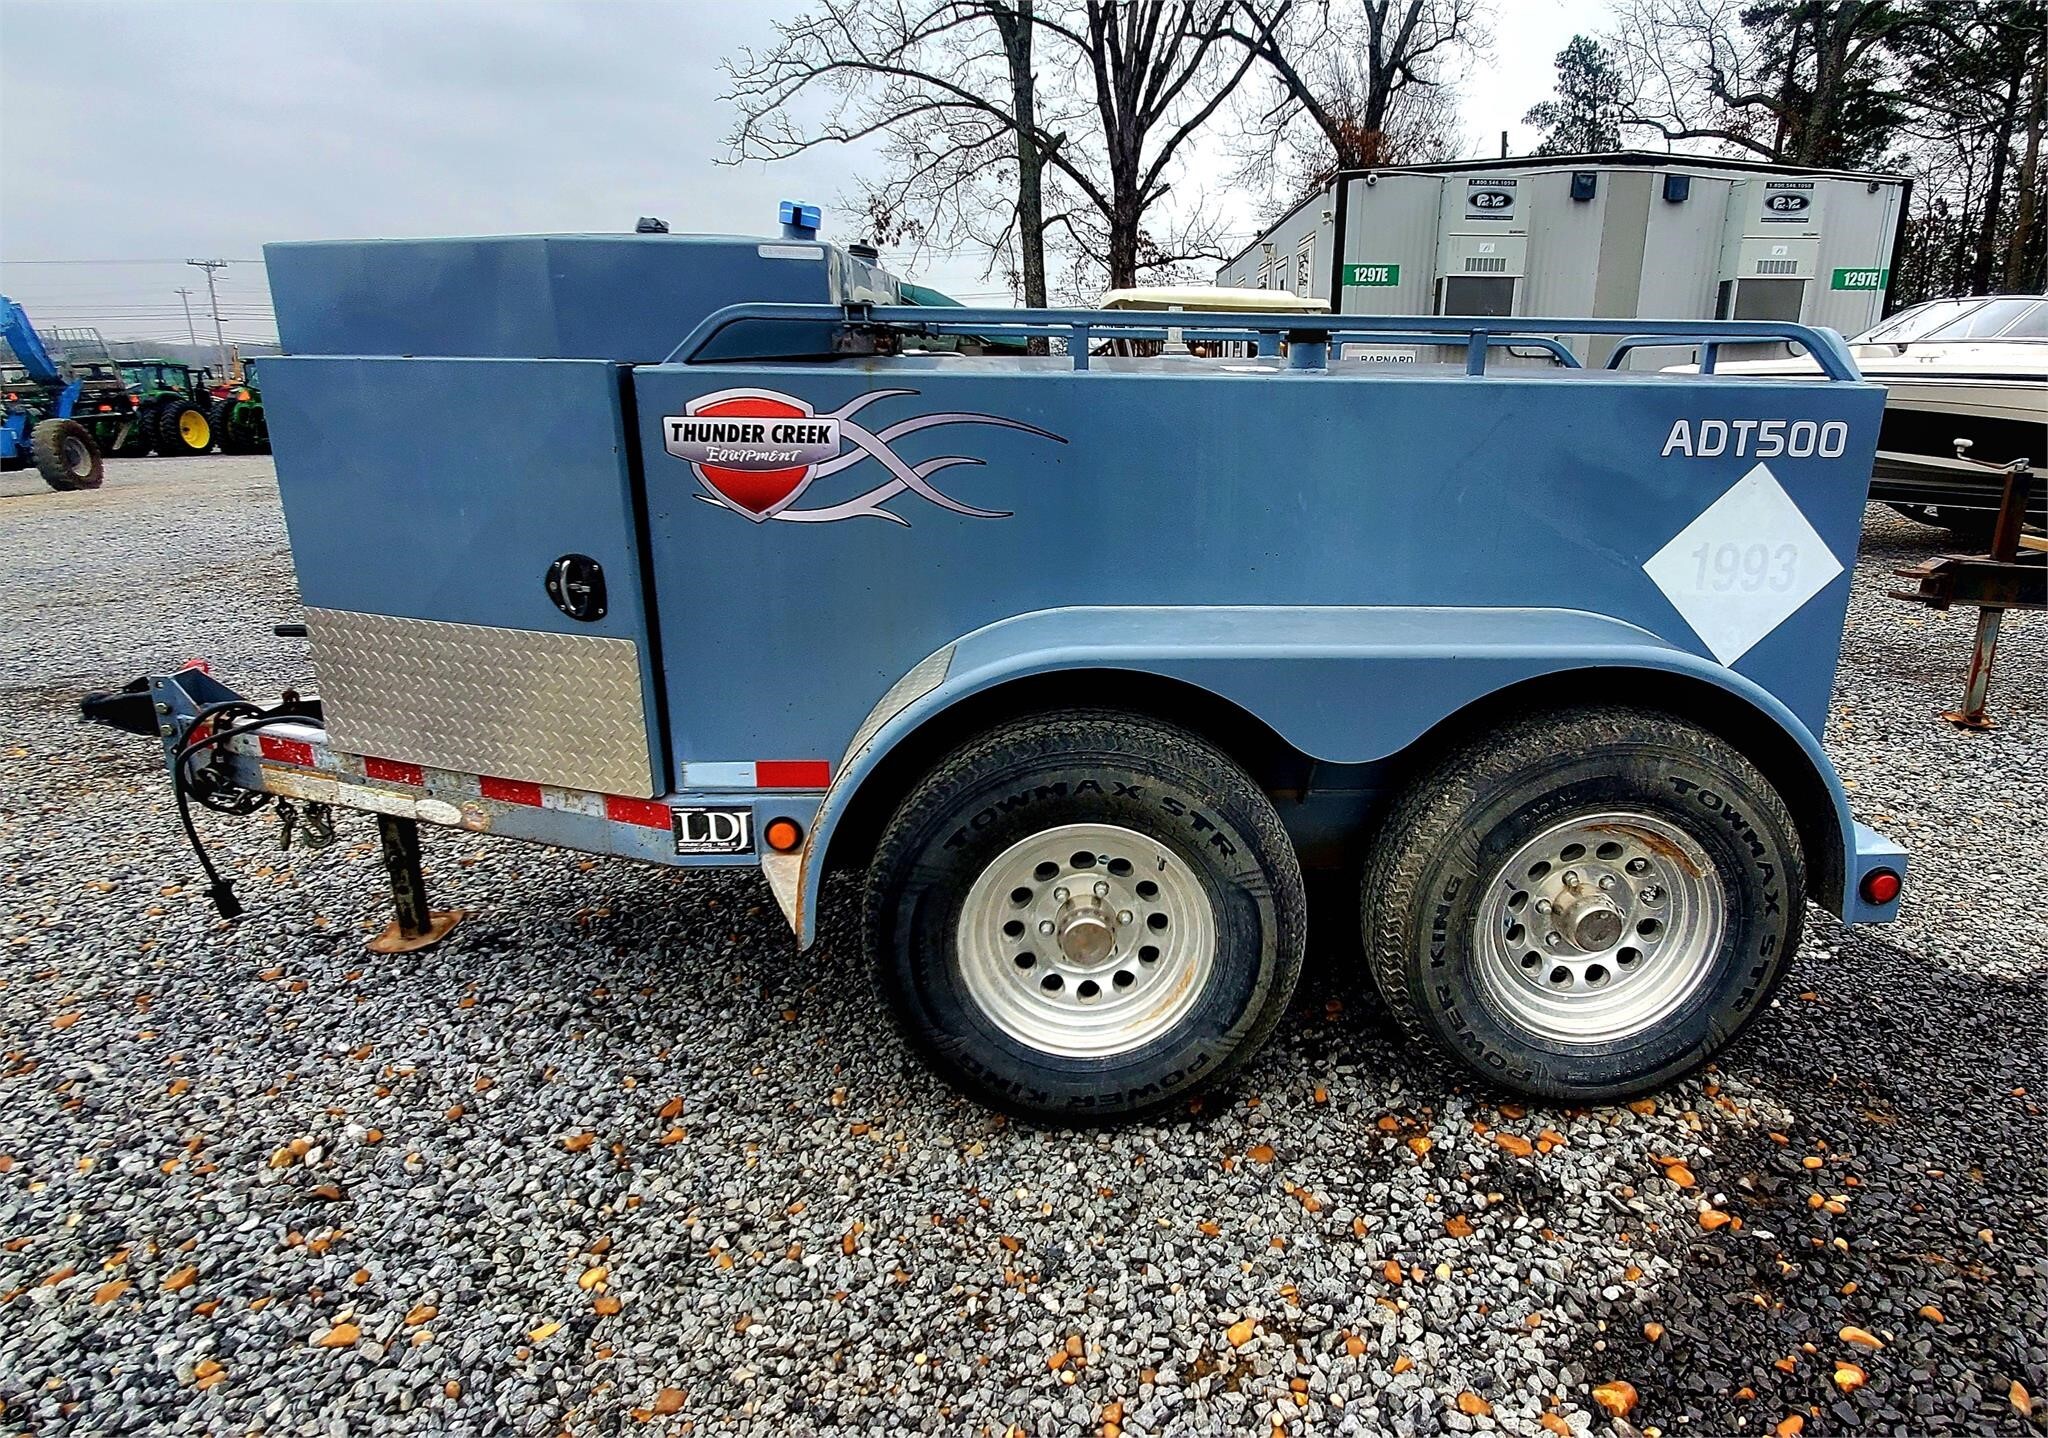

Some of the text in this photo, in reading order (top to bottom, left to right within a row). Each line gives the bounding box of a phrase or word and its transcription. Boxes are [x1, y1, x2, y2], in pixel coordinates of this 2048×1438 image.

[1353, 267, 1389, 282] 1297E
[1843, 272, 1879, 286] 1297E
[671, 423, 832, 444] THUNDER CREEK
[1661, 419, 1849, 459] ADT500
[1691, 541, 1799, 593] 1993
[673, 811, 753, 851] LDJ
[943, 779, 1237, 859] TOWMAX STR
[1669, 777, 1781, 1013] TOWMAX STR
[1430, 875, 1534, 1081] POWER KING
[1069, 1052, 1211, 1108] POWER
